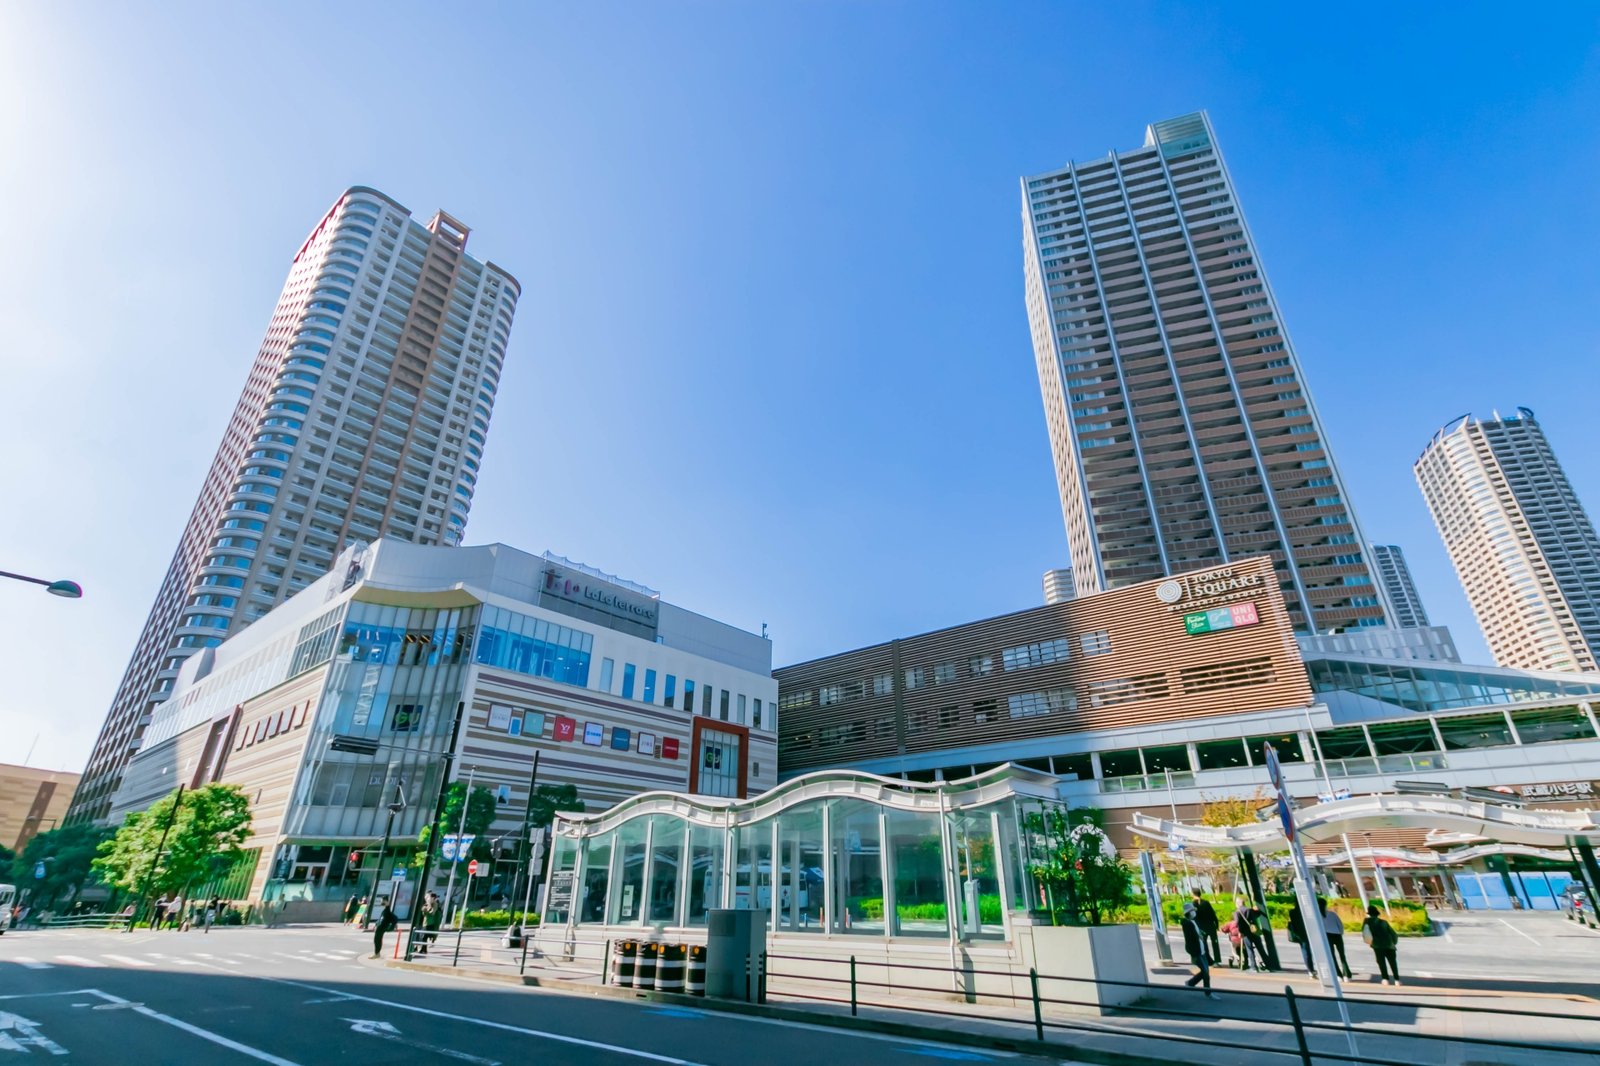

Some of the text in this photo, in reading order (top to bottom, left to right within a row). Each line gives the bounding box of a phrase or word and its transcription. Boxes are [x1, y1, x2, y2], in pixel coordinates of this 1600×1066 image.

[1192, 568, 1232, 583] TOKYU
[1195, 575, 1261, 597] SQUARE
[1235, 613, 1255, 624] QLO
